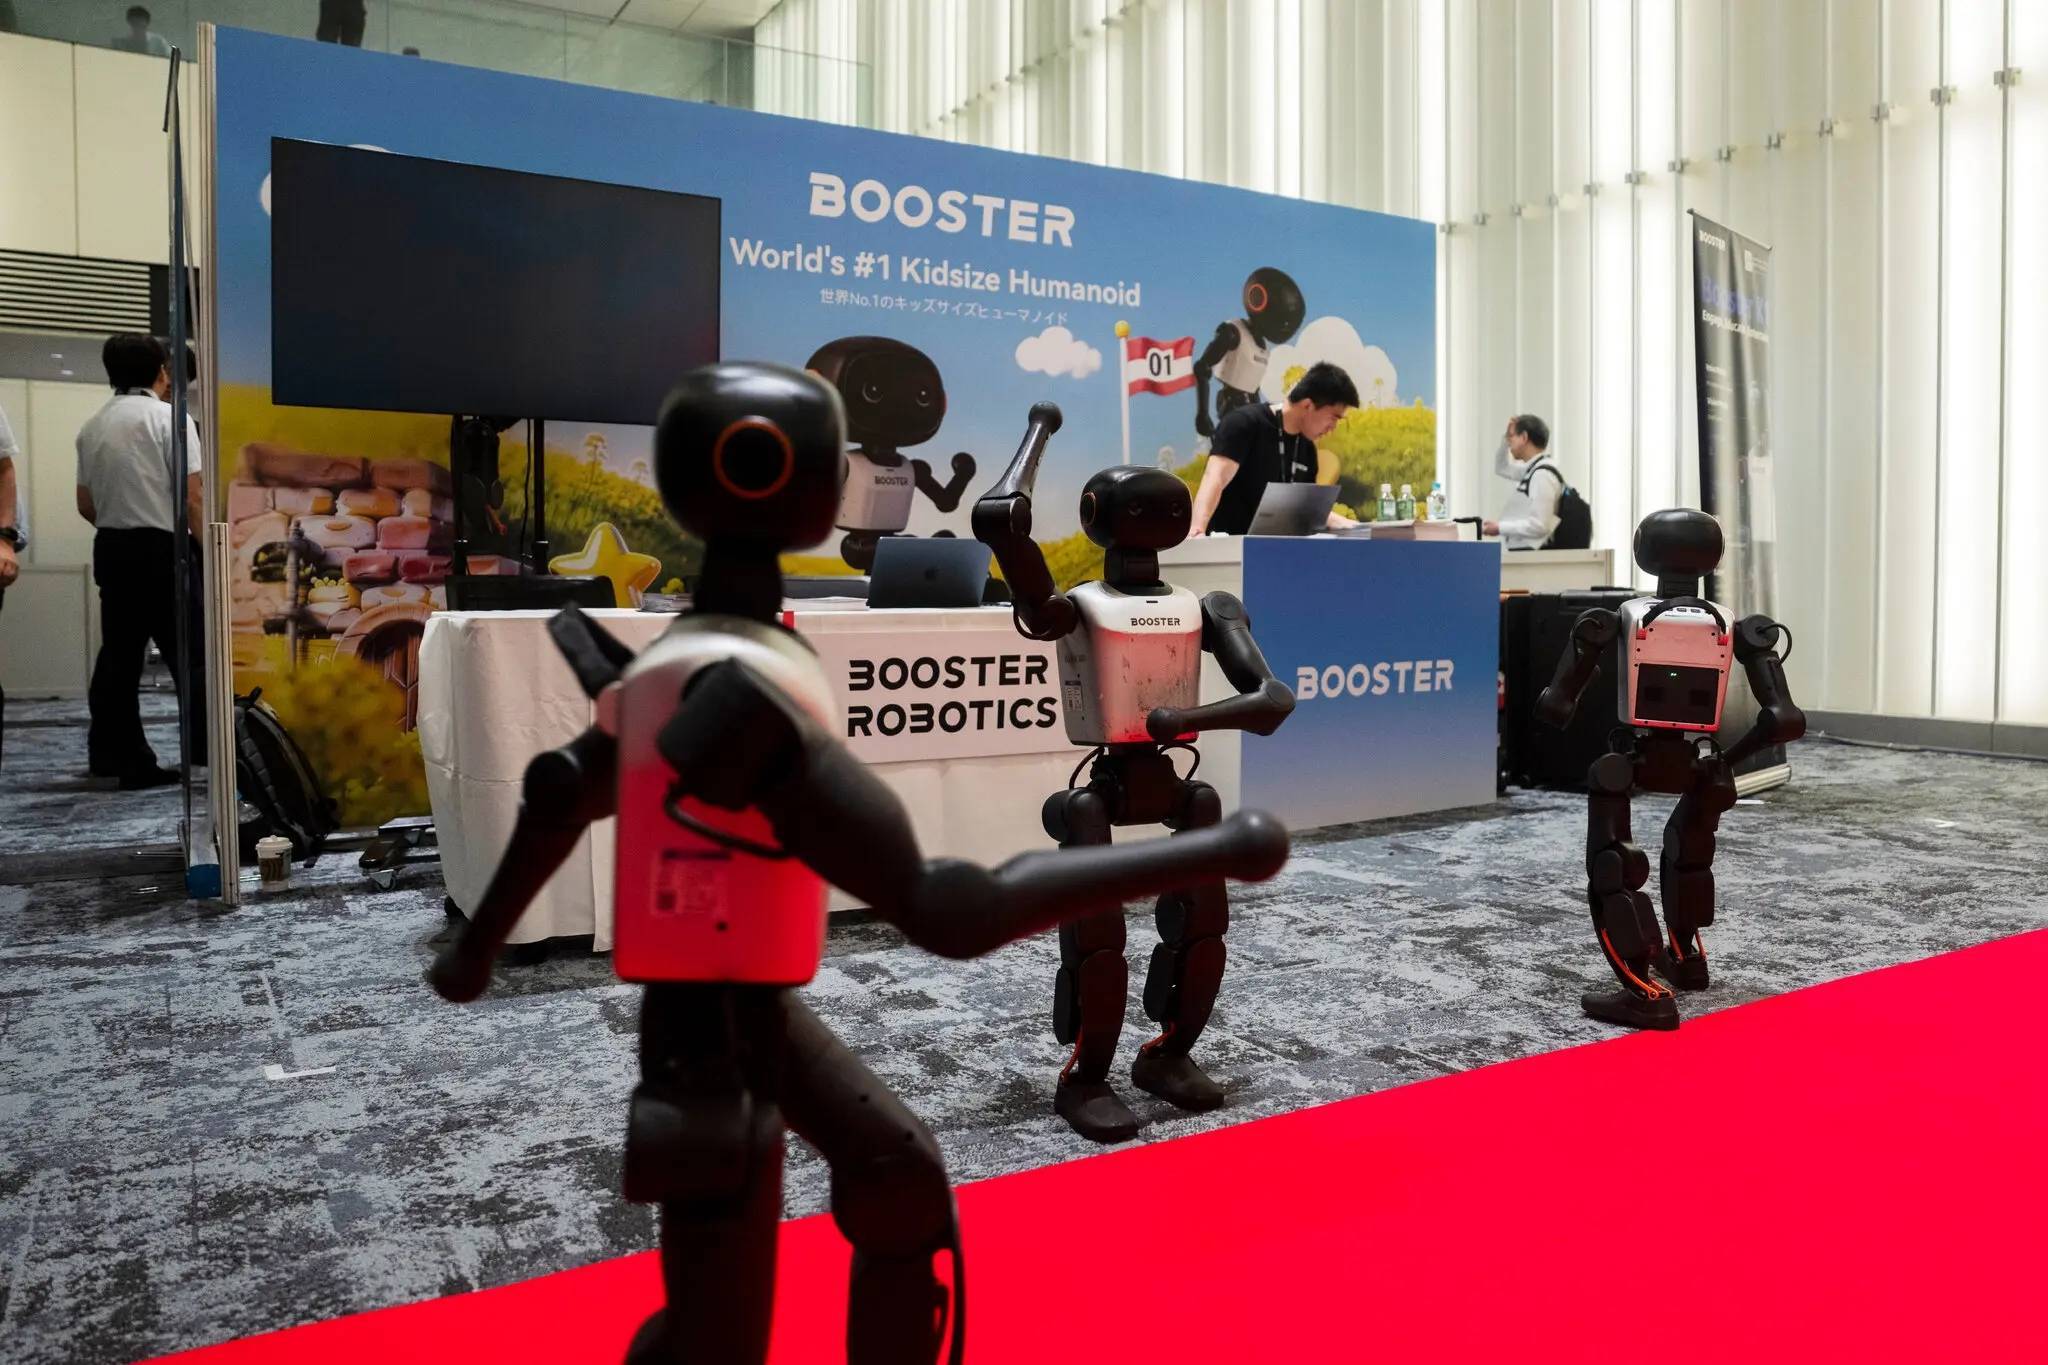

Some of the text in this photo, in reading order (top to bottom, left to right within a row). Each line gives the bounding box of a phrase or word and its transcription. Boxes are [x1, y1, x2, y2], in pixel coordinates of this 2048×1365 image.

[809, 172, 1076, 248] BOOSTER
[729, 237, 1141, 308] World's #1 Kidsize Humanoid
[819, 288, 1068, 326] 世界No.1のキッズサイズヒューマノイド
[1149, 351, 1172, 377] 01
[874, 475, 909, 486] BOOSTER
[1130, 617, 1181, 626] BOOSTER
[848, 654, 1049, 691] BOOSTER
[1296, 659, 1455, 701] BOOSTER
[847, 696, 1058, 738] ROBOTICS
